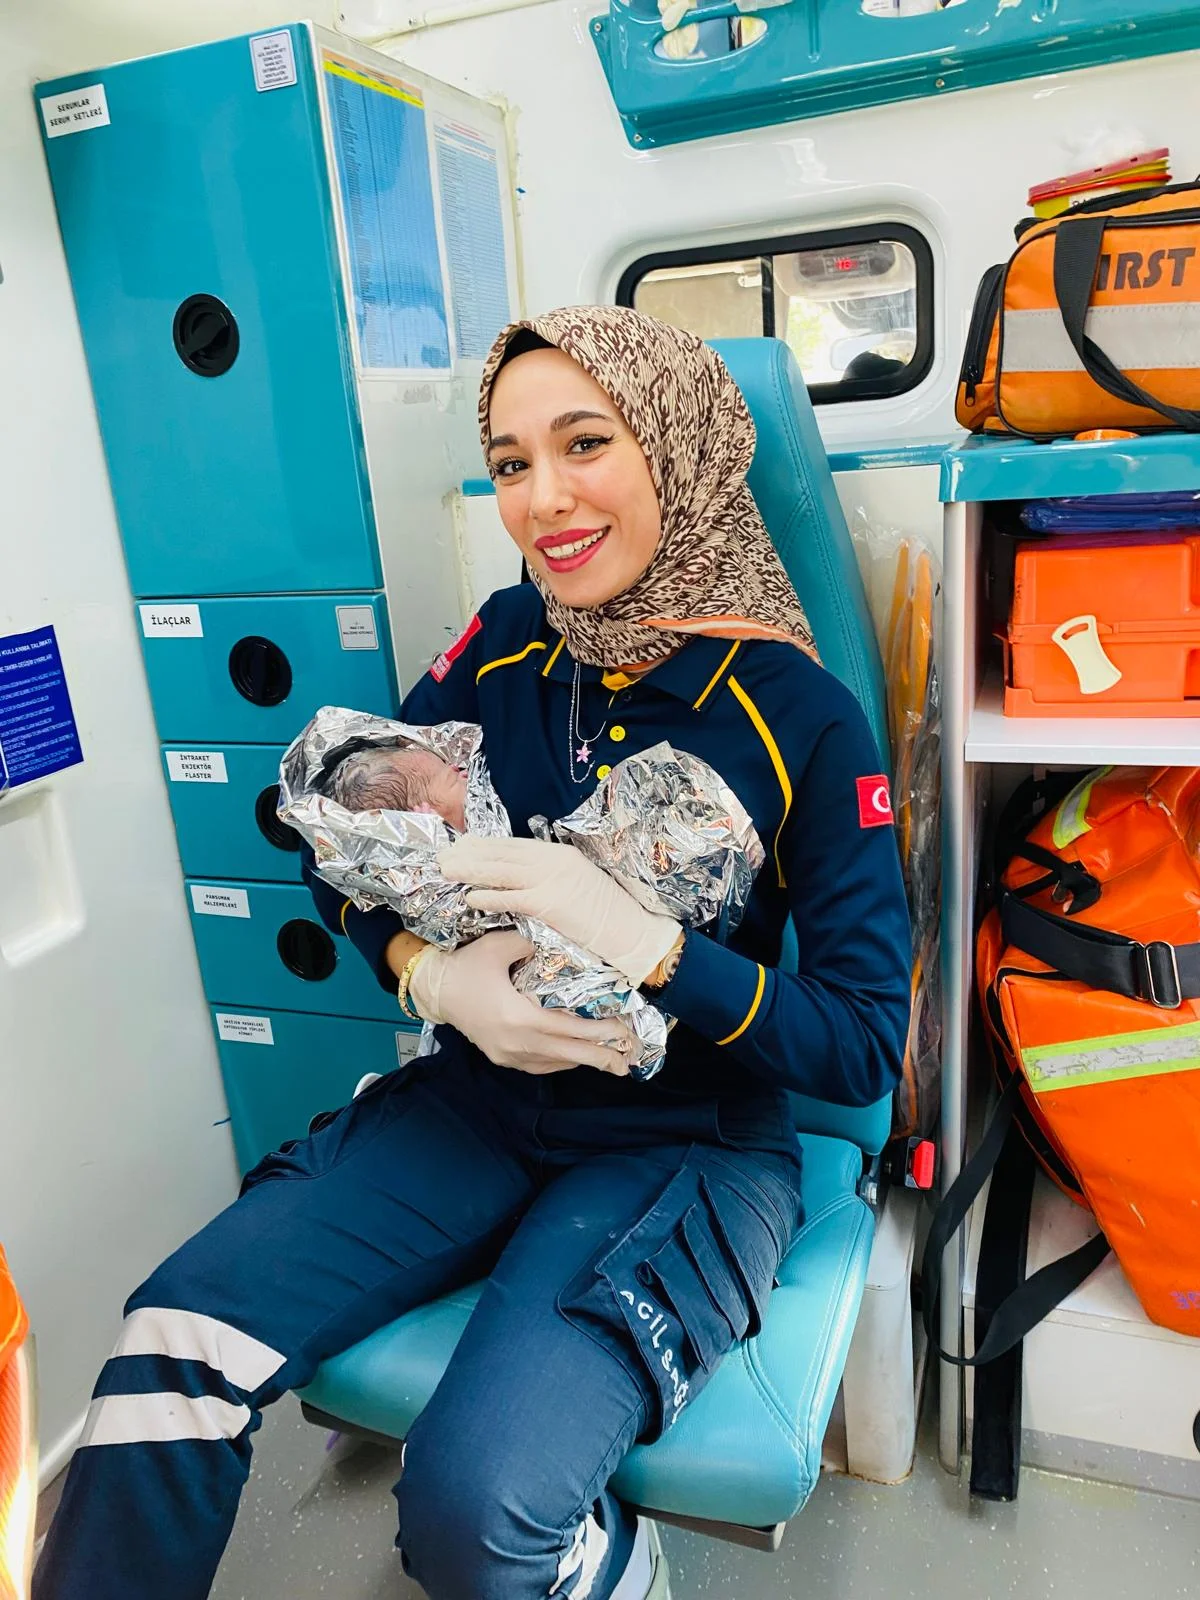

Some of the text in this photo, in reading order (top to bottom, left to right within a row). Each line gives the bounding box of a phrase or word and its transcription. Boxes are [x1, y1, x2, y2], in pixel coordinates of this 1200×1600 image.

[49, 105, 102, 127] SERUM SETLERİ
[57, 98, 90, 112] SERUMLAR
[1095, 247, 1196, 291] IRST
[151, 614, 192, 628] İLAÇLAR
[620, 1290, 689, 1424] ACİL SAĞL
